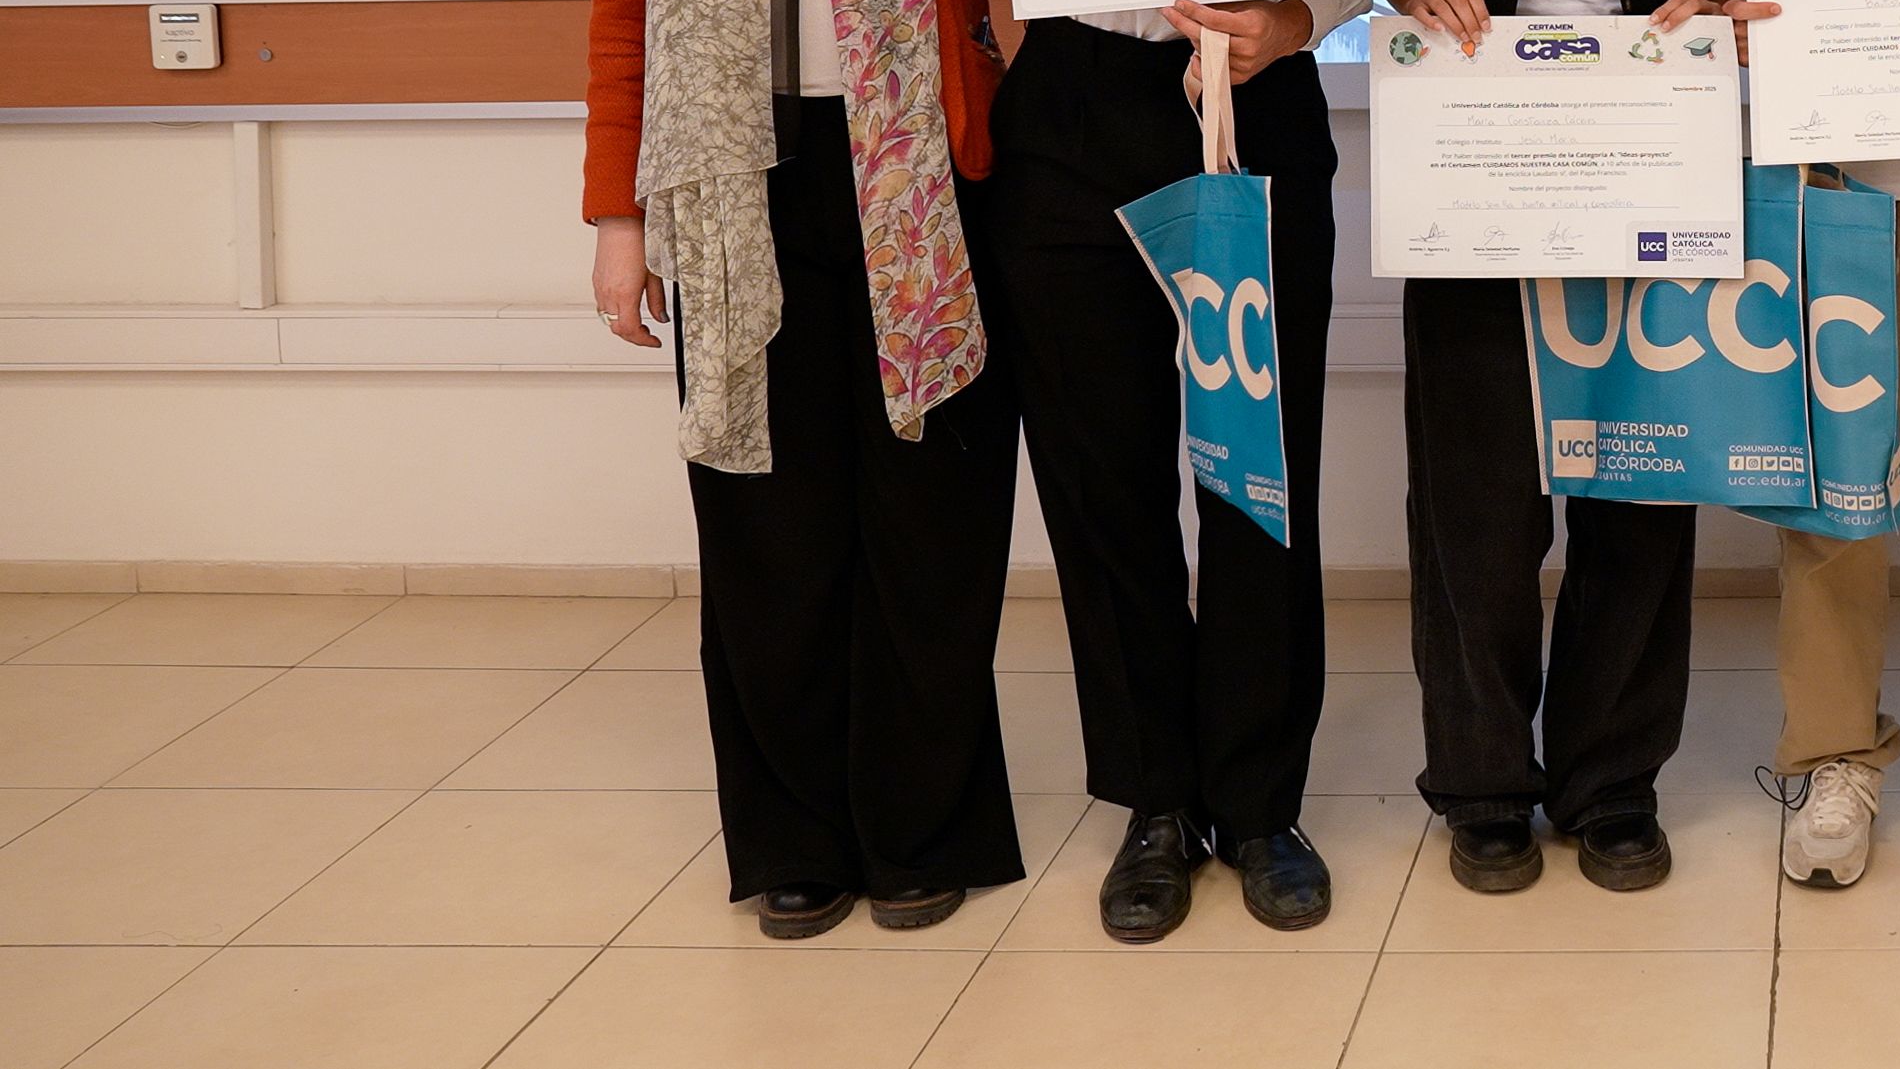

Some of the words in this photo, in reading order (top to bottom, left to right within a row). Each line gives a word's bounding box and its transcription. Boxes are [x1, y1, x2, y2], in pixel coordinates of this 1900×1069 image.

[1515, 36, 1599, 59] casa
[1861, 44, 1898, 52] CUIDAMOS
[1559, 51, 1597, 62] común
[1672, 230, 1732, 238] UNIVERSIDAD
[1640, 241, 1664, 252] UCC
[1686, 246, 1729, 255] CÓRDOBA
[1536, 259, 1797, 373] UCC
[1171, 268, 1274, 400] CC
[1599, 421, 1689, 438] UNIVERSIDAD
[1558, 439, 1594, 458] UCC
[1599, 436, 1657, 454] CATÓLICA
[1728, 444, 1787, 453] COMUNIDAD
[1789, 445, 1804, 455] UCC
[1606, 453, 1686, 473] CÓRDOBA
[1728, 475, 1806, 488] ucc.edu.ar
